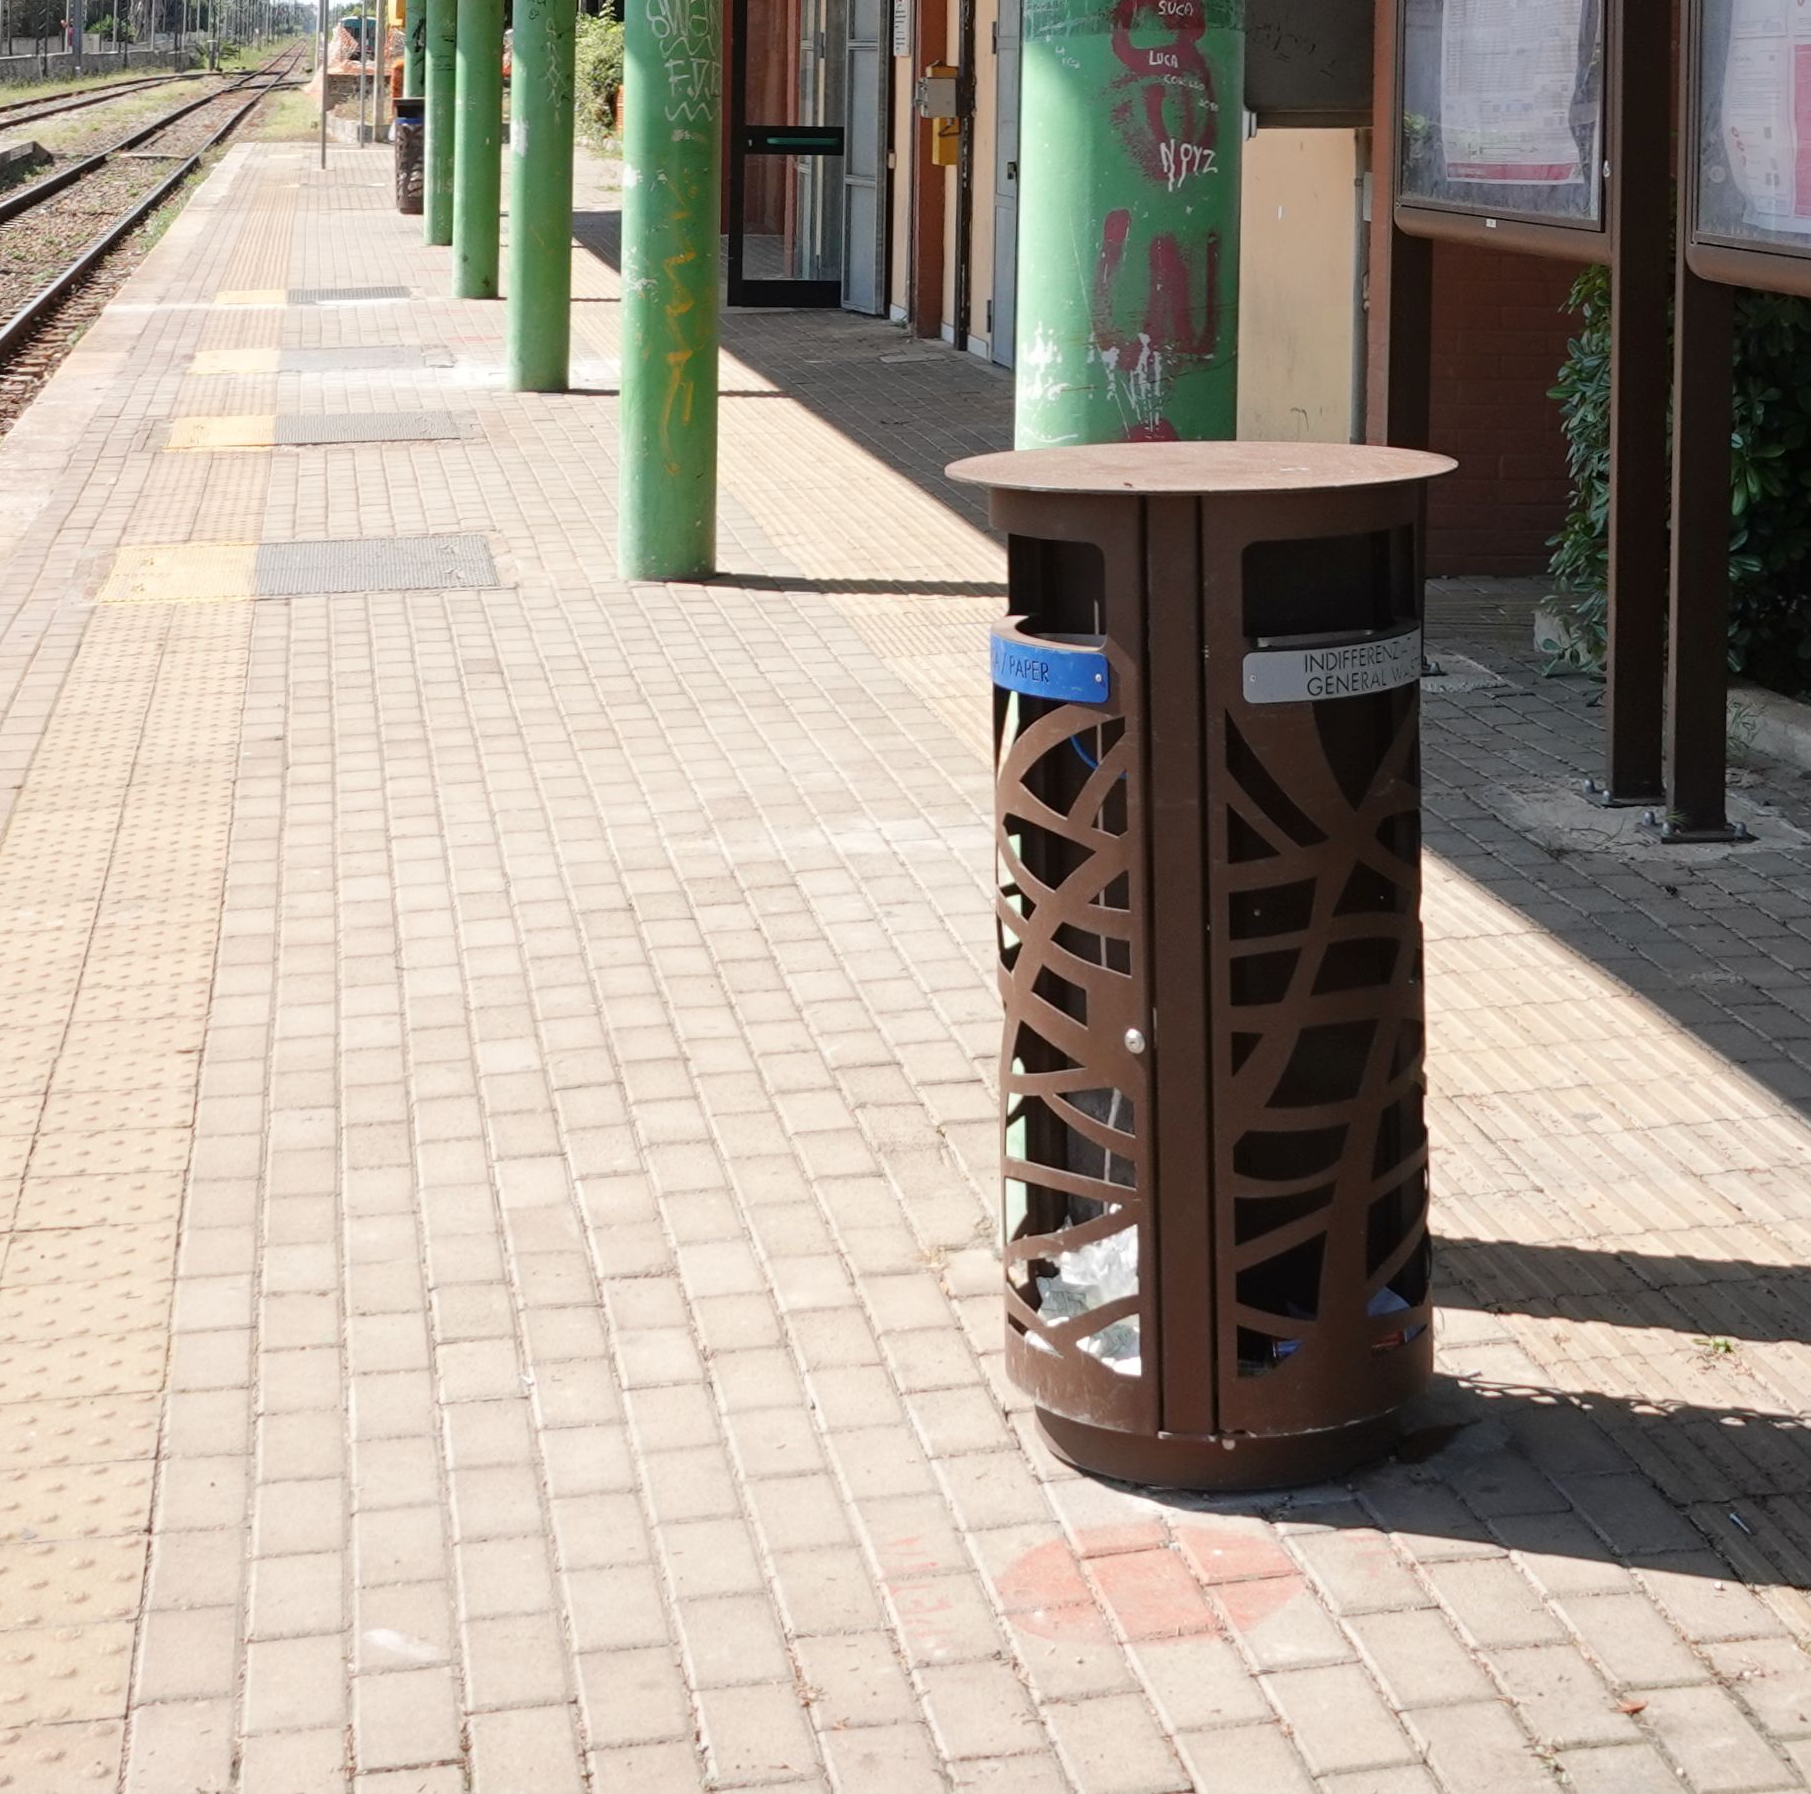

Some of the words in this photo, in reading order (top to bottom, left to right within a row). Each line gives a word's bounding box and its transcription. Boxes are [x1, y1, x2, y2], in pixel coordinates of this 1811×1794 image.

[1157, 0, 1194, 17] SUCA
[1148, 49, 1179, 68] LUCA
[1159, 139, 1218, 189] NOYZ
[1008, 655, 1050, 683] PAPER
[1306, 668, 1388, 697] GENERAL
